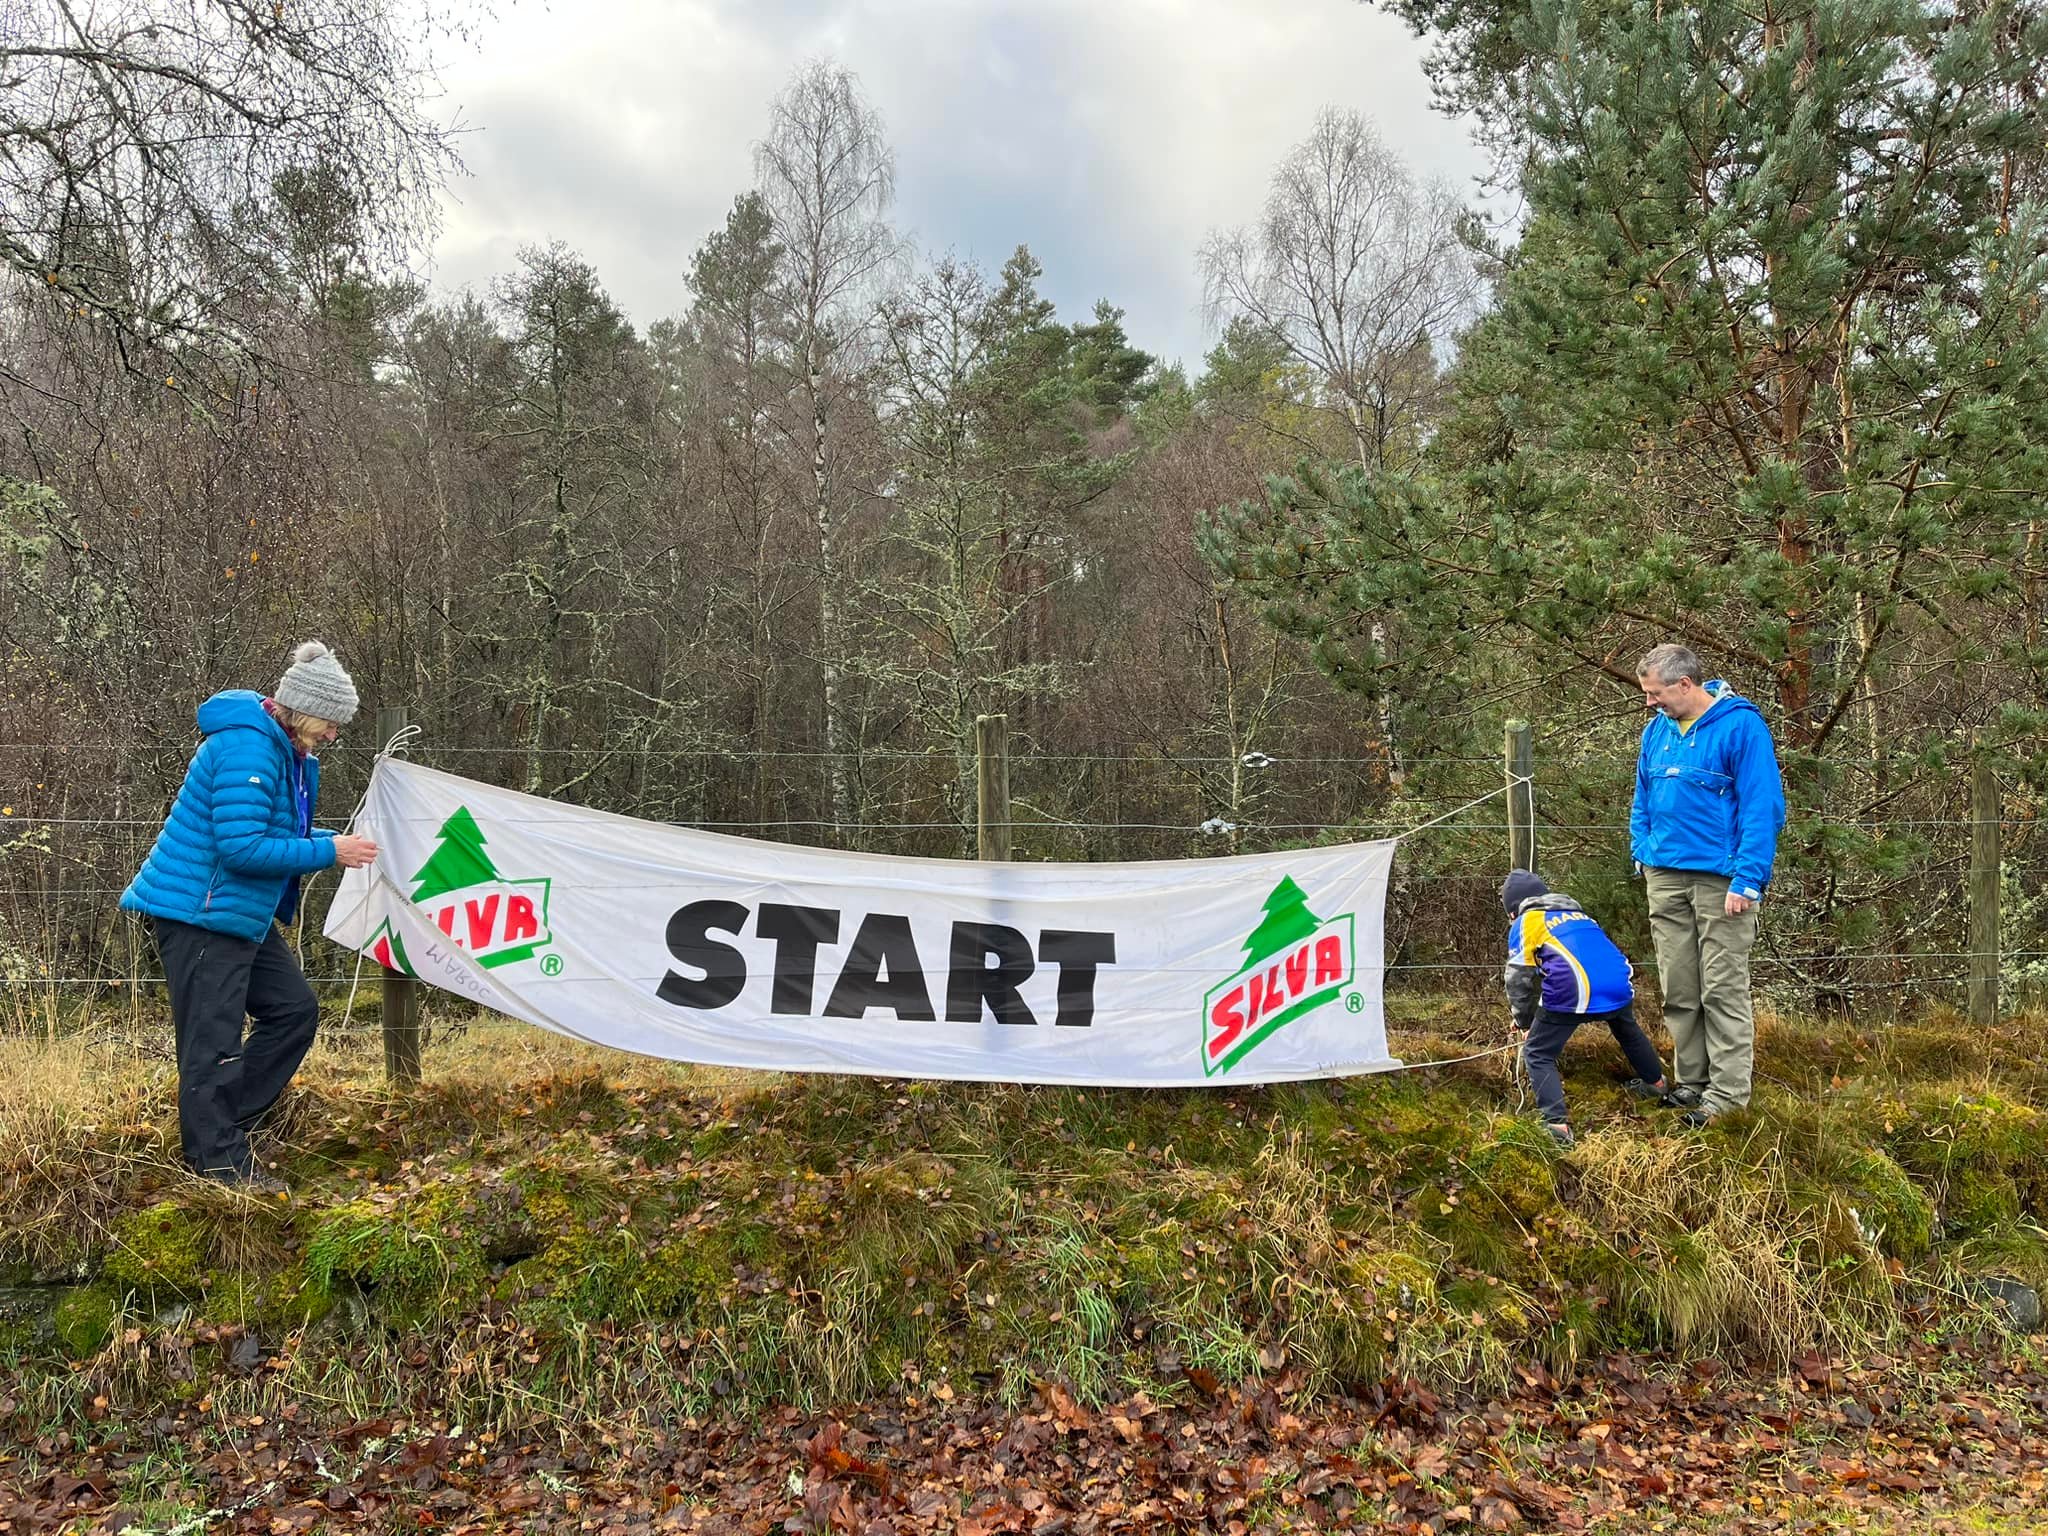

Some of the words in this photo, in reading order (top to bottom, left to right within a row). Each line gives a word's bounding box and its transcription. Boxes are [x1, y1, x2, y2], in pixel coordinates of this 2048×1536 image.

[426, 893, 538, 950] LVA
[655, 899, 1117, 1027] START
[1208, 934, 1343, 1059] SILVA
